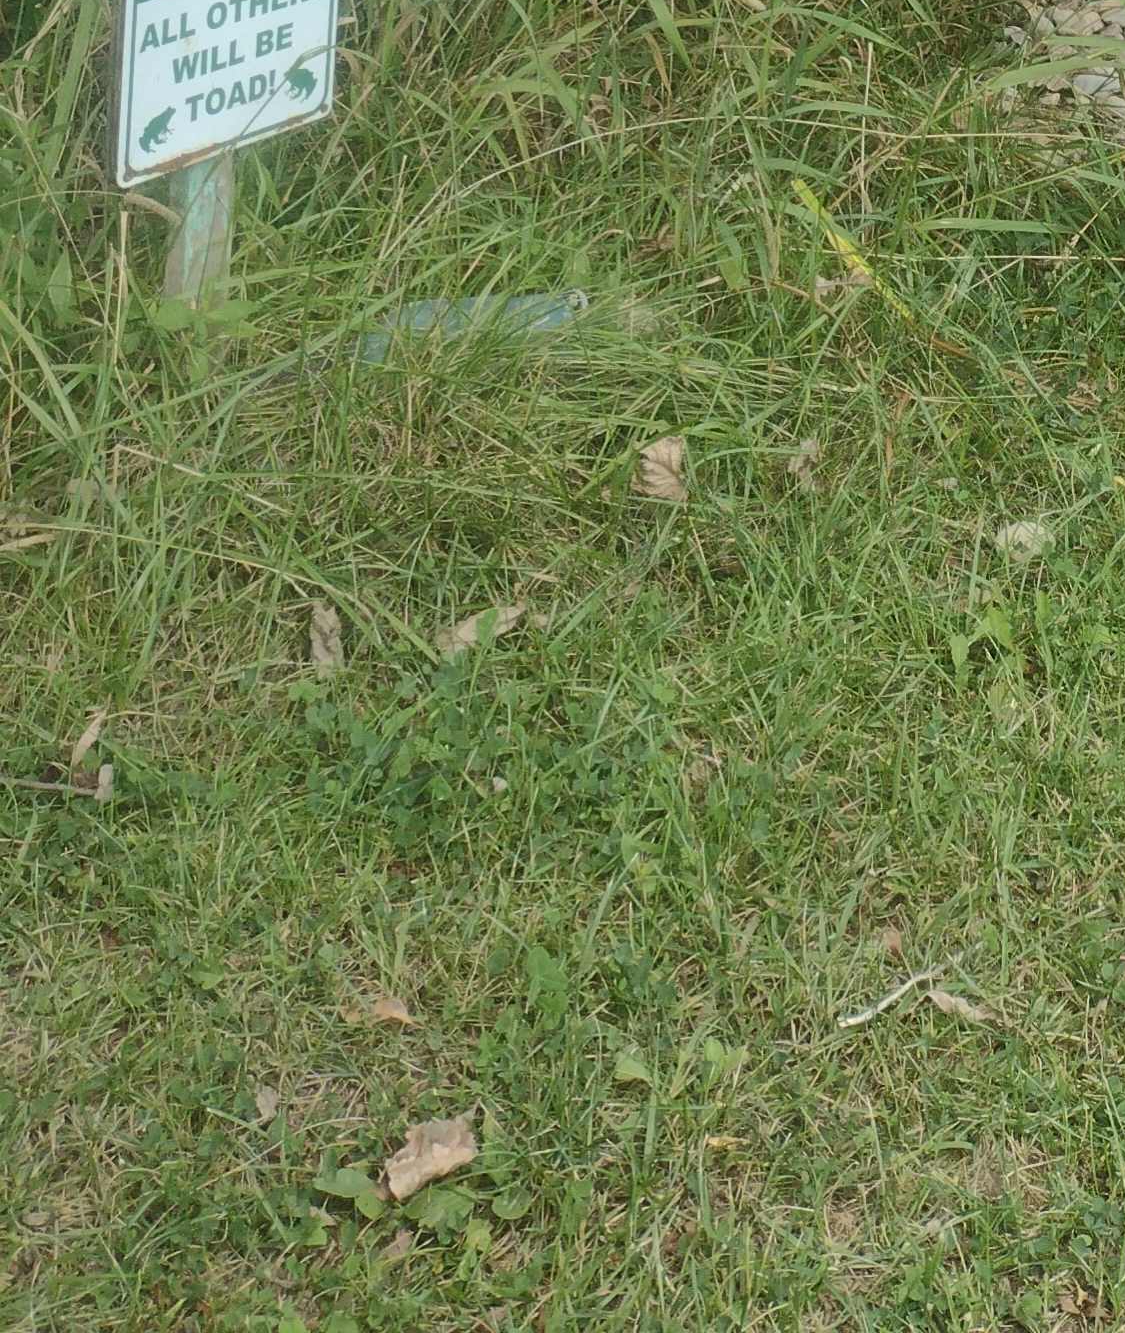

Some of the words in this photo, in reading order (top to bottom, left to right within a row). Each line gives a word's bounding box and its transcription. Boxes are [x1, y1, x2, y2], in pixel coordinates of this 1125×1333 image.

[140, 13, 196, 53] ALL
[172, 40, 245, 84] WILL
[255, 22, 294, 58] BE
[185, 69, 276, 122] TOAD!
